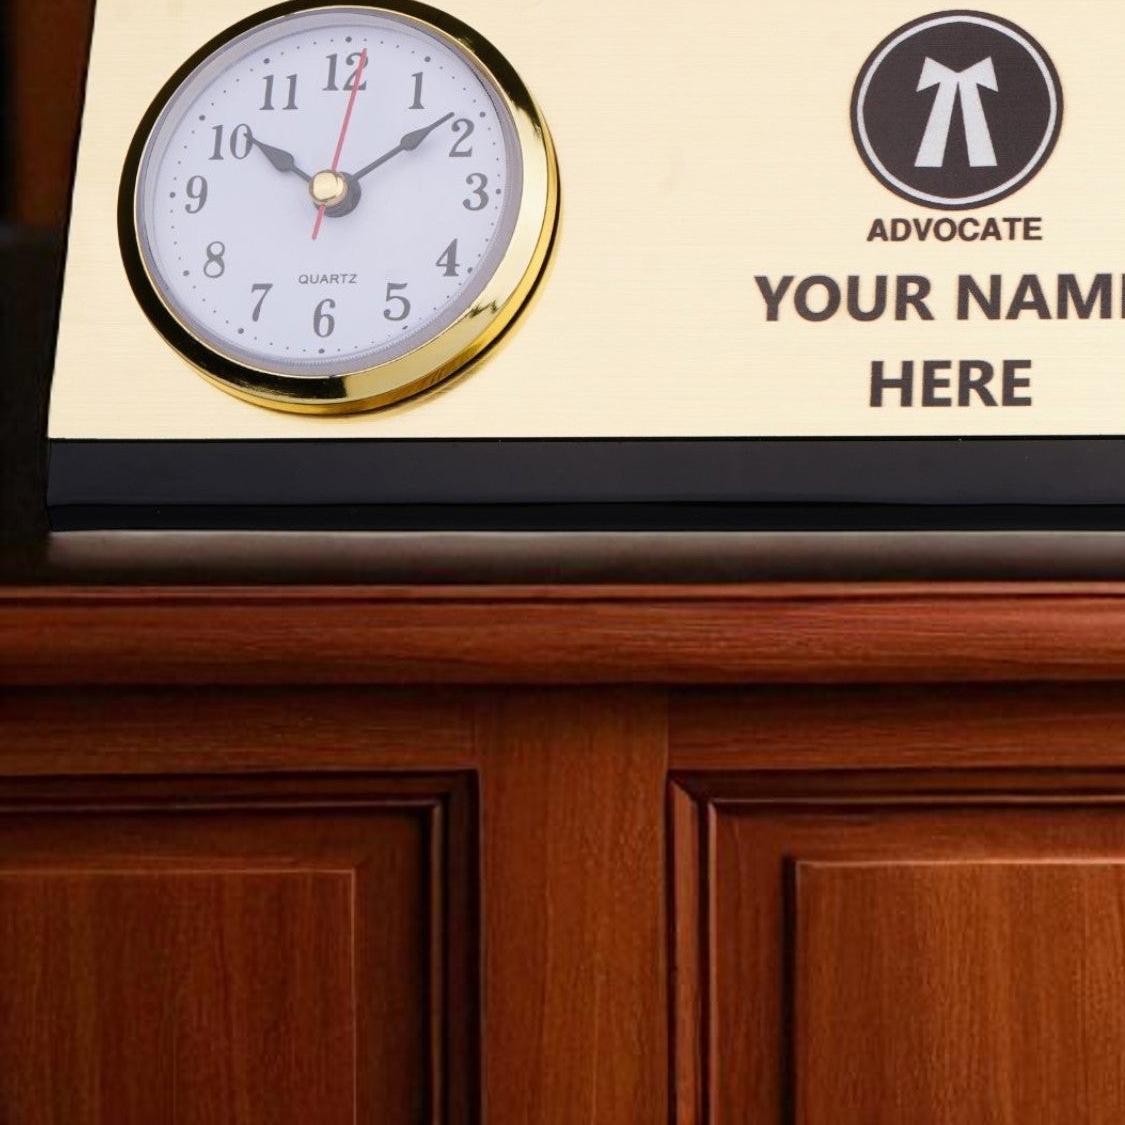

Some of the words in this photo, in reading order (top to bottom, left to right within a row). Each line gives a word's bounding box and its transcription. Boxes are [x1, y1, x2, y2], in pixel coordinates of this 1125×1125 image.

[322, 52, 369, 91] 12
[408, 71, 425, 110] 1
[259, 73, 299, 111] 11
[208, 123, 254, 161] 10
[448, 118, 475, 159] 2
[184, 175, 208, 214] 9
[462, 172, 490, 212] 3
[866, 217, 1043, 242] ADVOCATE
[202, 241, 226, 279] 8
[435, 238, 461, 278] 4
[298, 273, 358, 286] QUARTZ
[753, 274, 935, 323] YOUR
[250, 282, 274, 323] 7
[312, 298, 336, 339] 6
[383, 282, 412, 322] 5
[869, 359, 1032, 408] HERE
